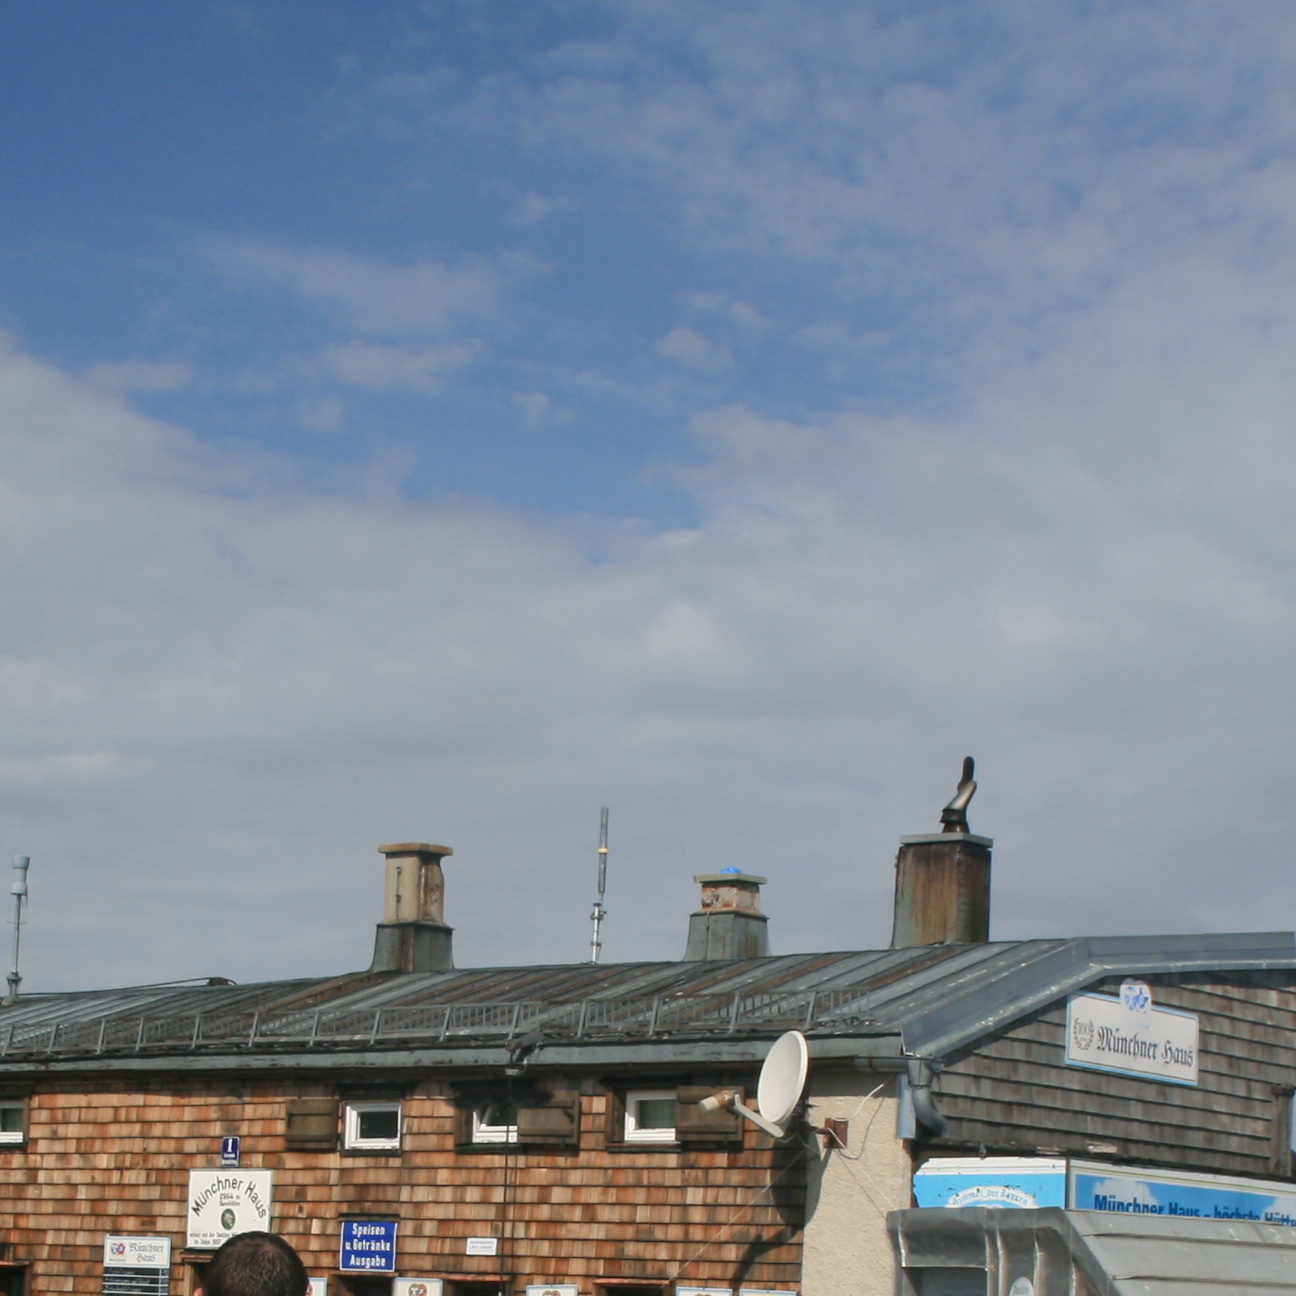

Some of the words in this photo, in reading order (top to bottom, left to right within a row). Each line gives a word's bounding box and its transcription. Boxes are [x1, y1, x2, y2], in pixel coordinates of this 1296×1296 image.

[1097, 1026, 1158, 1061] Münchner
[1161, 1039, 1195, 1068] Haus
[226, 1138, 233, 1152] 1
[245, 1181, 266, 1218] Haus
[1094, 1194, 1165, 1215] Münchner
[352, 1222, 386, 1238] Speisen
[353, 1238, 391, 1252] Getränke
[349, 1254, 386, 1269] Ausgabe
